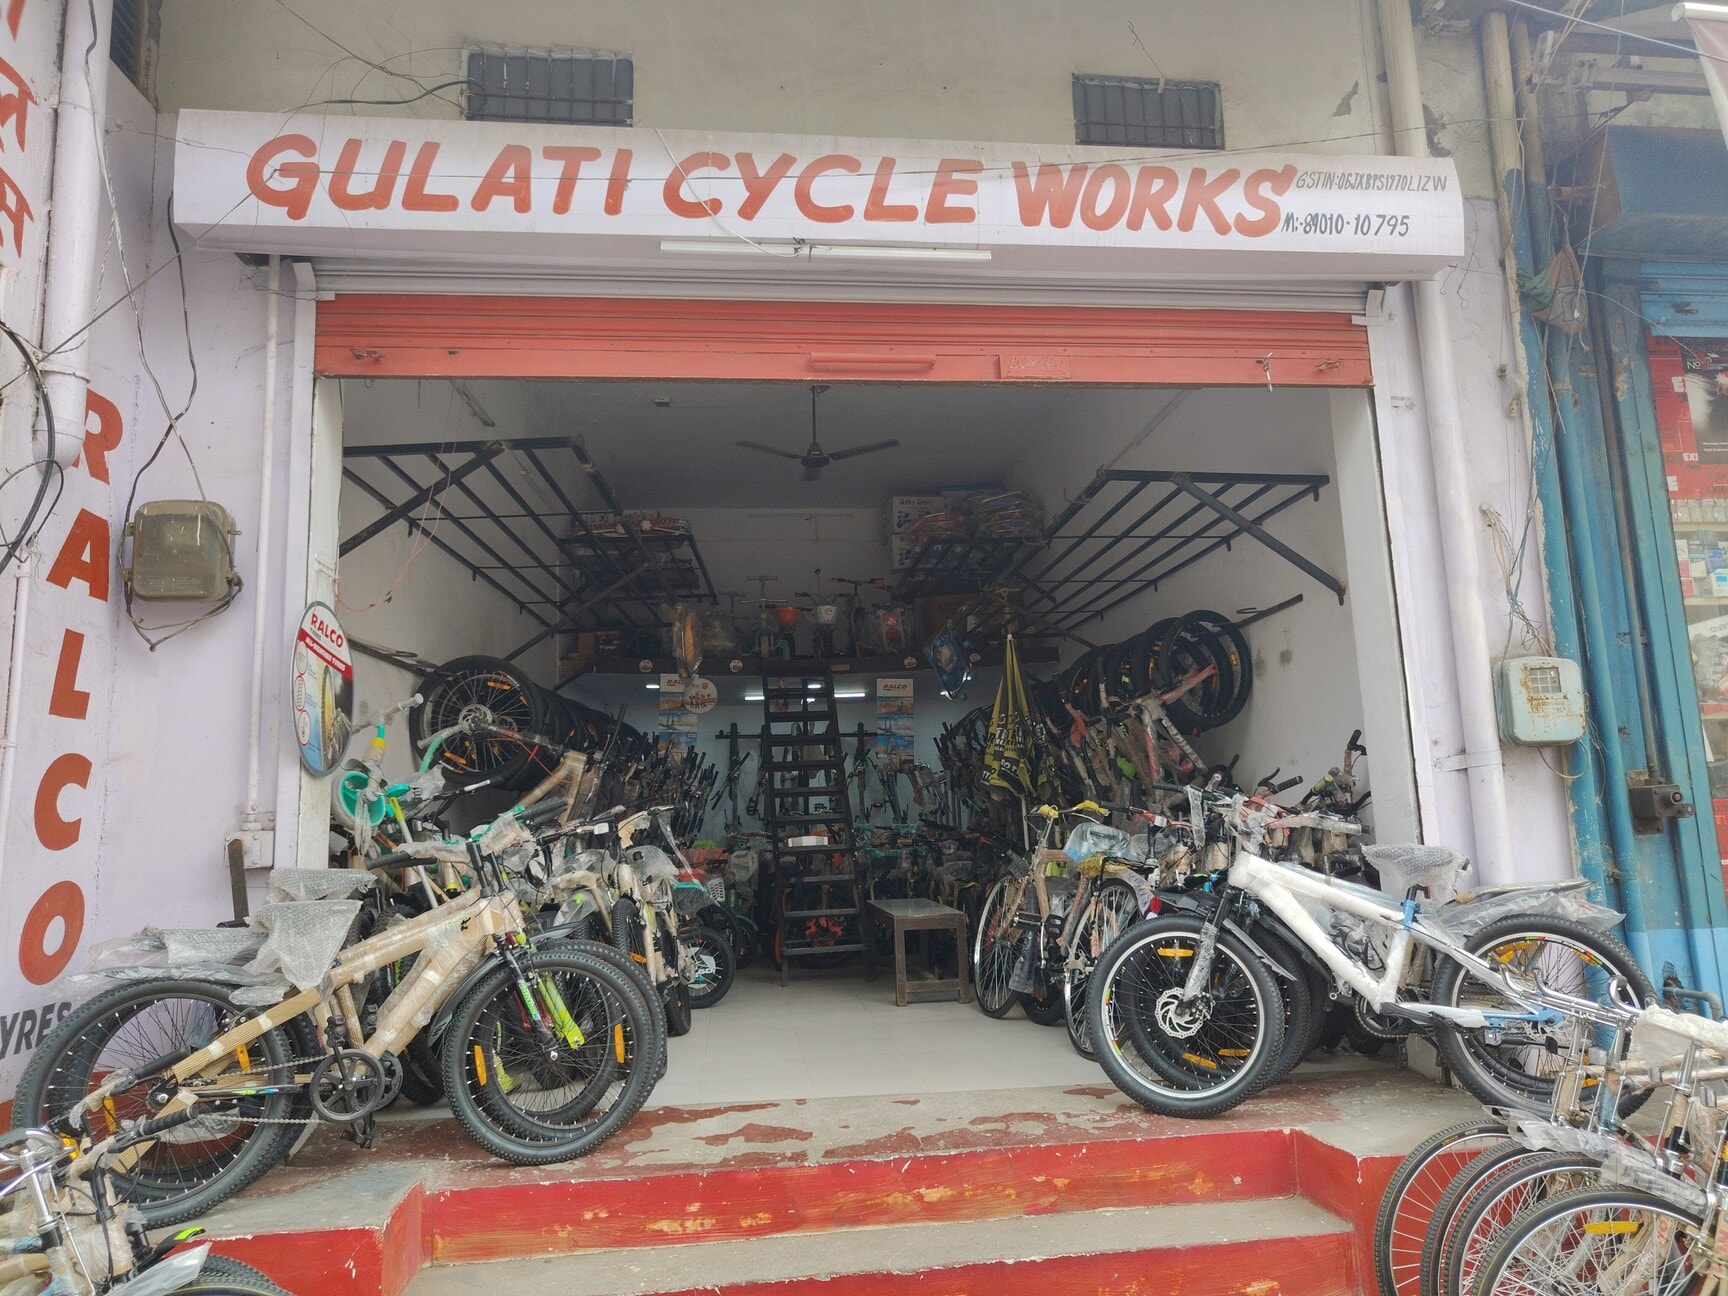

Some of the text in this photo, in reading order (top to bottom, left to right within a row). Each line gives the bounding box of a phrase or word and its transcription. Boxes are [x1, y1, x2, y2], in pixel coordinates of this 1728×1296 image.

[247, 135, 1297, 237] GULATI CYCLE WORKS
[311, 612, 343, 648] RALCO
[19, 388, 124, 986] RALCO
